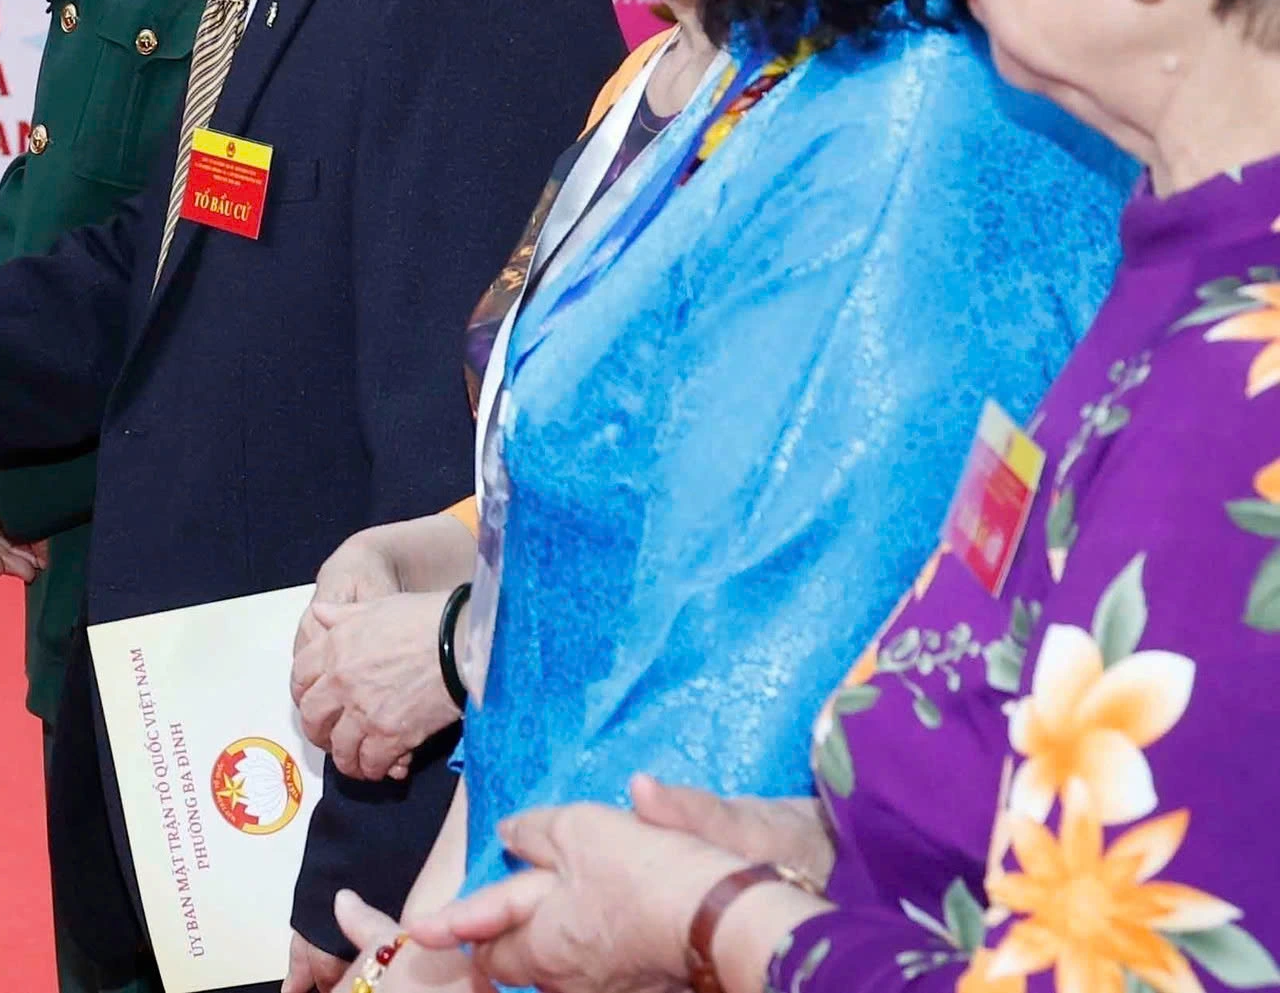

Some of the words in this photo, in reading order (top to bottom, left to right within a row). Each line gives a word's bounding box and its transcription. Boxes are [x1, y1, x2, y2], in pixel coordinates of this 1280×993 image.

[194, 188, 211, 208] TỔ
[210, 192, 234, 216] BẦU
[233, 201, 252, 221] CỬ
[130, 647, 148, 686] NAM
[138, 689, 156, 728] VIỆT
[144, 730, 168, 778] QUỐC
[170, 722, 190, 767] ĐÌNH
[152, 782, 172, 804] TỔ
[181, 771, 195, 793] BA
[162, 807, 181, 853] TRẬN
[172, 856, 190, 892] MẶT
[180, 896, 199, 931] BAN
[189, 935, 205, 957] ỦY
